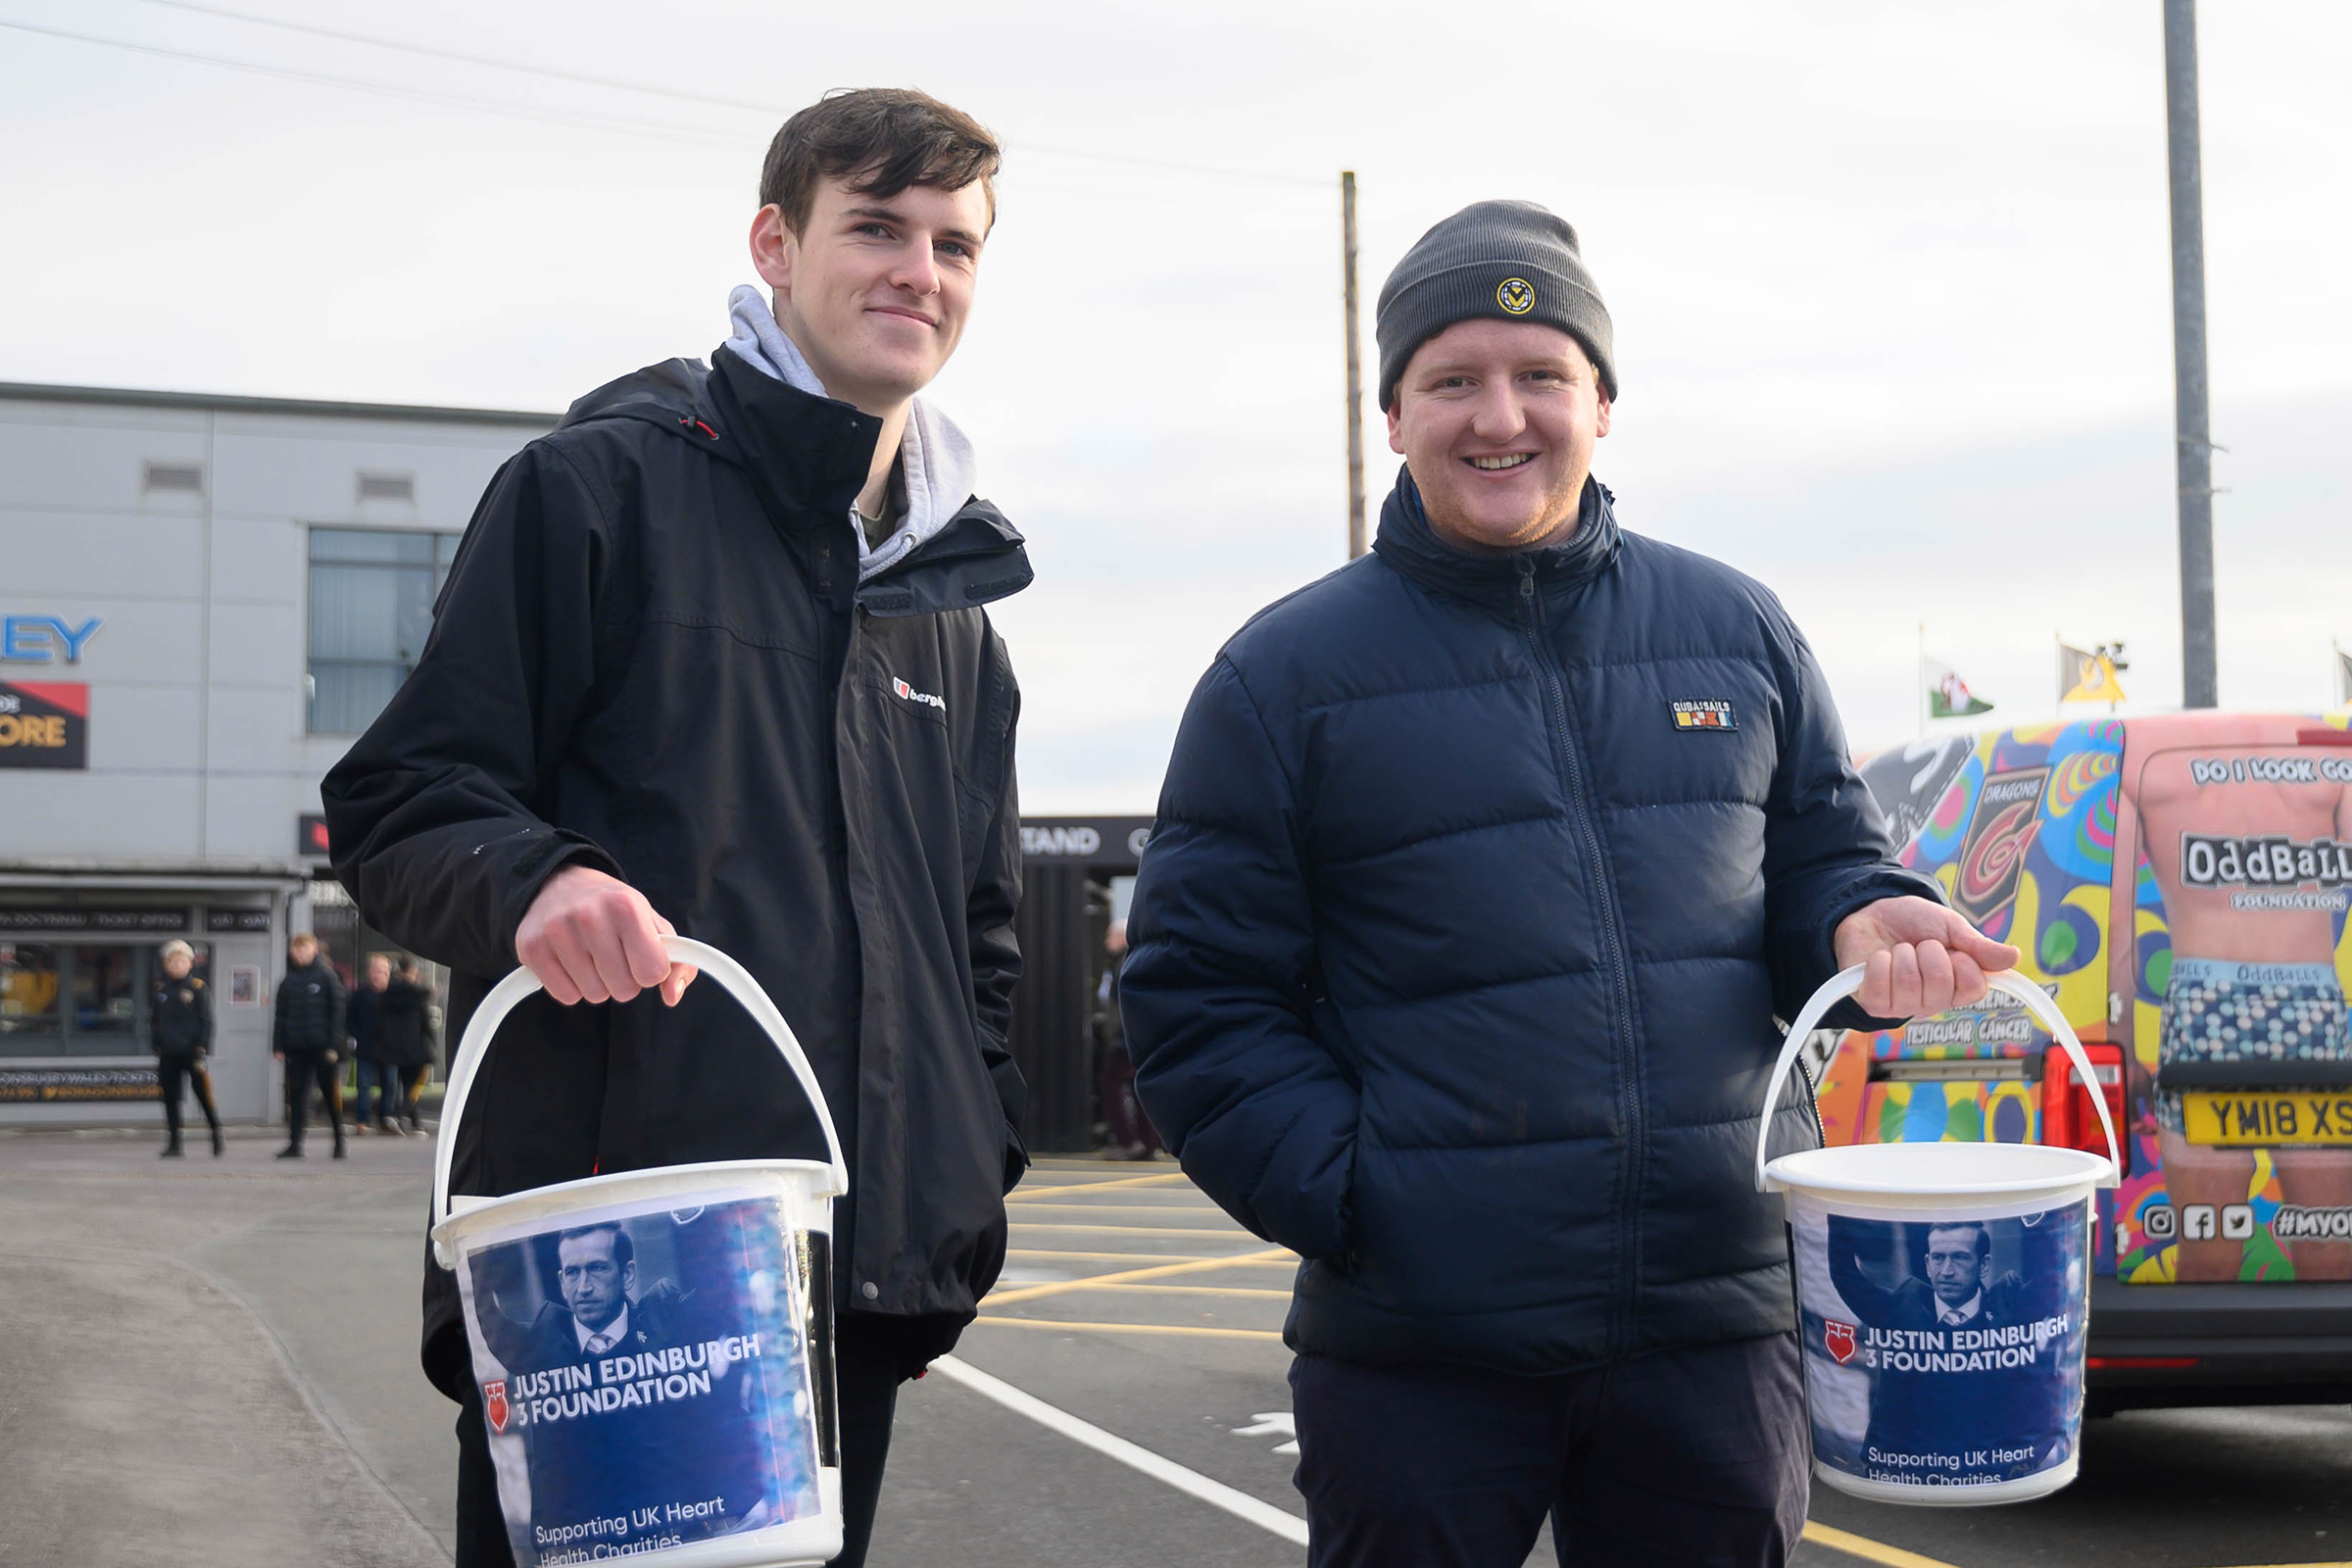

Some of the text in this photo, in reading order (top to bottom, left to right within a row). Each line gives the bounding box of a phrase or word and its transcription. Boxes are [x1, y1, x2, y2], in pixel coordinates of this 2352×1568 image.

[2190, 759, 2230, 784] DO
[2231, 759, 2246, 783] I
[2248, 758, 2317, 783] LOOK
[1984, 778, 2041, 804] DRAGONS
[2231, 894, 2345, 909] FOUNDATION
[1906, 1016, 2032, 1045] TESTICULAR CANCER
[2210, 1100, 2298, 1136] YM18
[2277, 1211, 2352, 1237] #MYO
[1864, 1313, 2069, 1350] JUSTIN EDINBURGH
[514, 1333, 760, 1399] JUSTIN EDINBURGH
[1865, 1345, 2035, 1372] 3 FOUNDATION
[515, 1369, 712, 1427] 3 FOUNDATION
[1868, 1445, 2034, 1468] Supporting UK Heart
[1869, 1468, 2001, 1487] Health Charities
[536, 1495, 726, 1544] Supporting UK Heart
[540, 1533, 683, 1568] Health Charities
